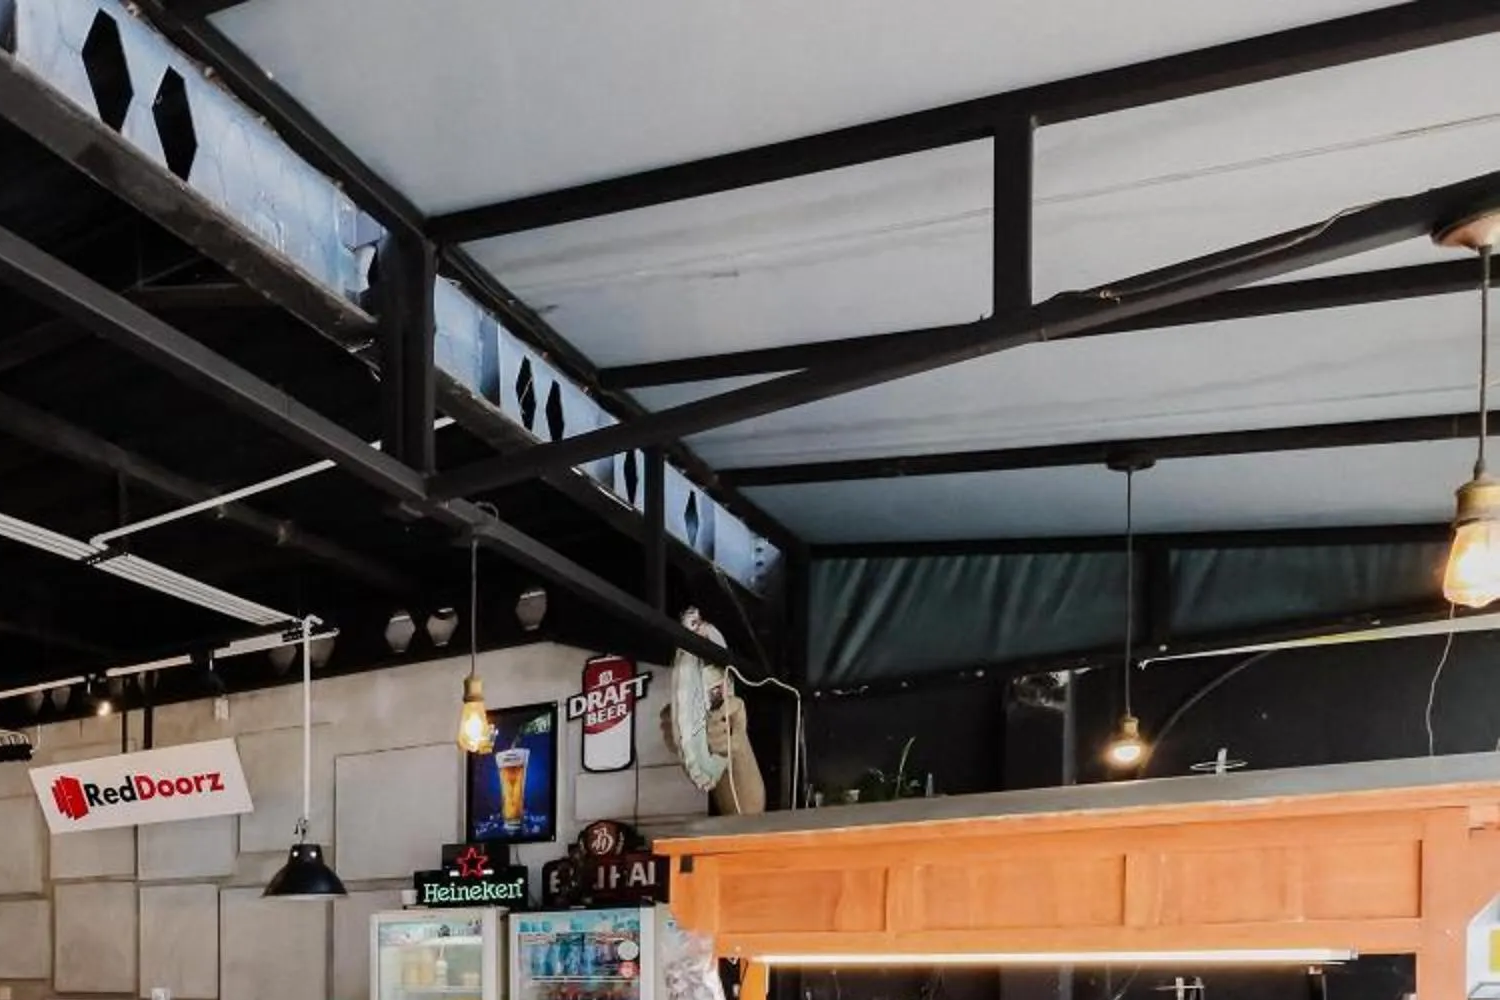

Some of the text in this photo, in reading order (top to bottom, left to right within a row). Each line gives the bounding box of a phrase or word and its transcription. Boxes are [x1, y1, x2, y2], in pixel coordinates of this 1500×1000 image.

[569, 675, 649, 719] DRAFT
[587, 703, 627, 725] BEER
[84, 773, 225, 807] RedDoorz
[423, 881, 523, 903] Heineken
